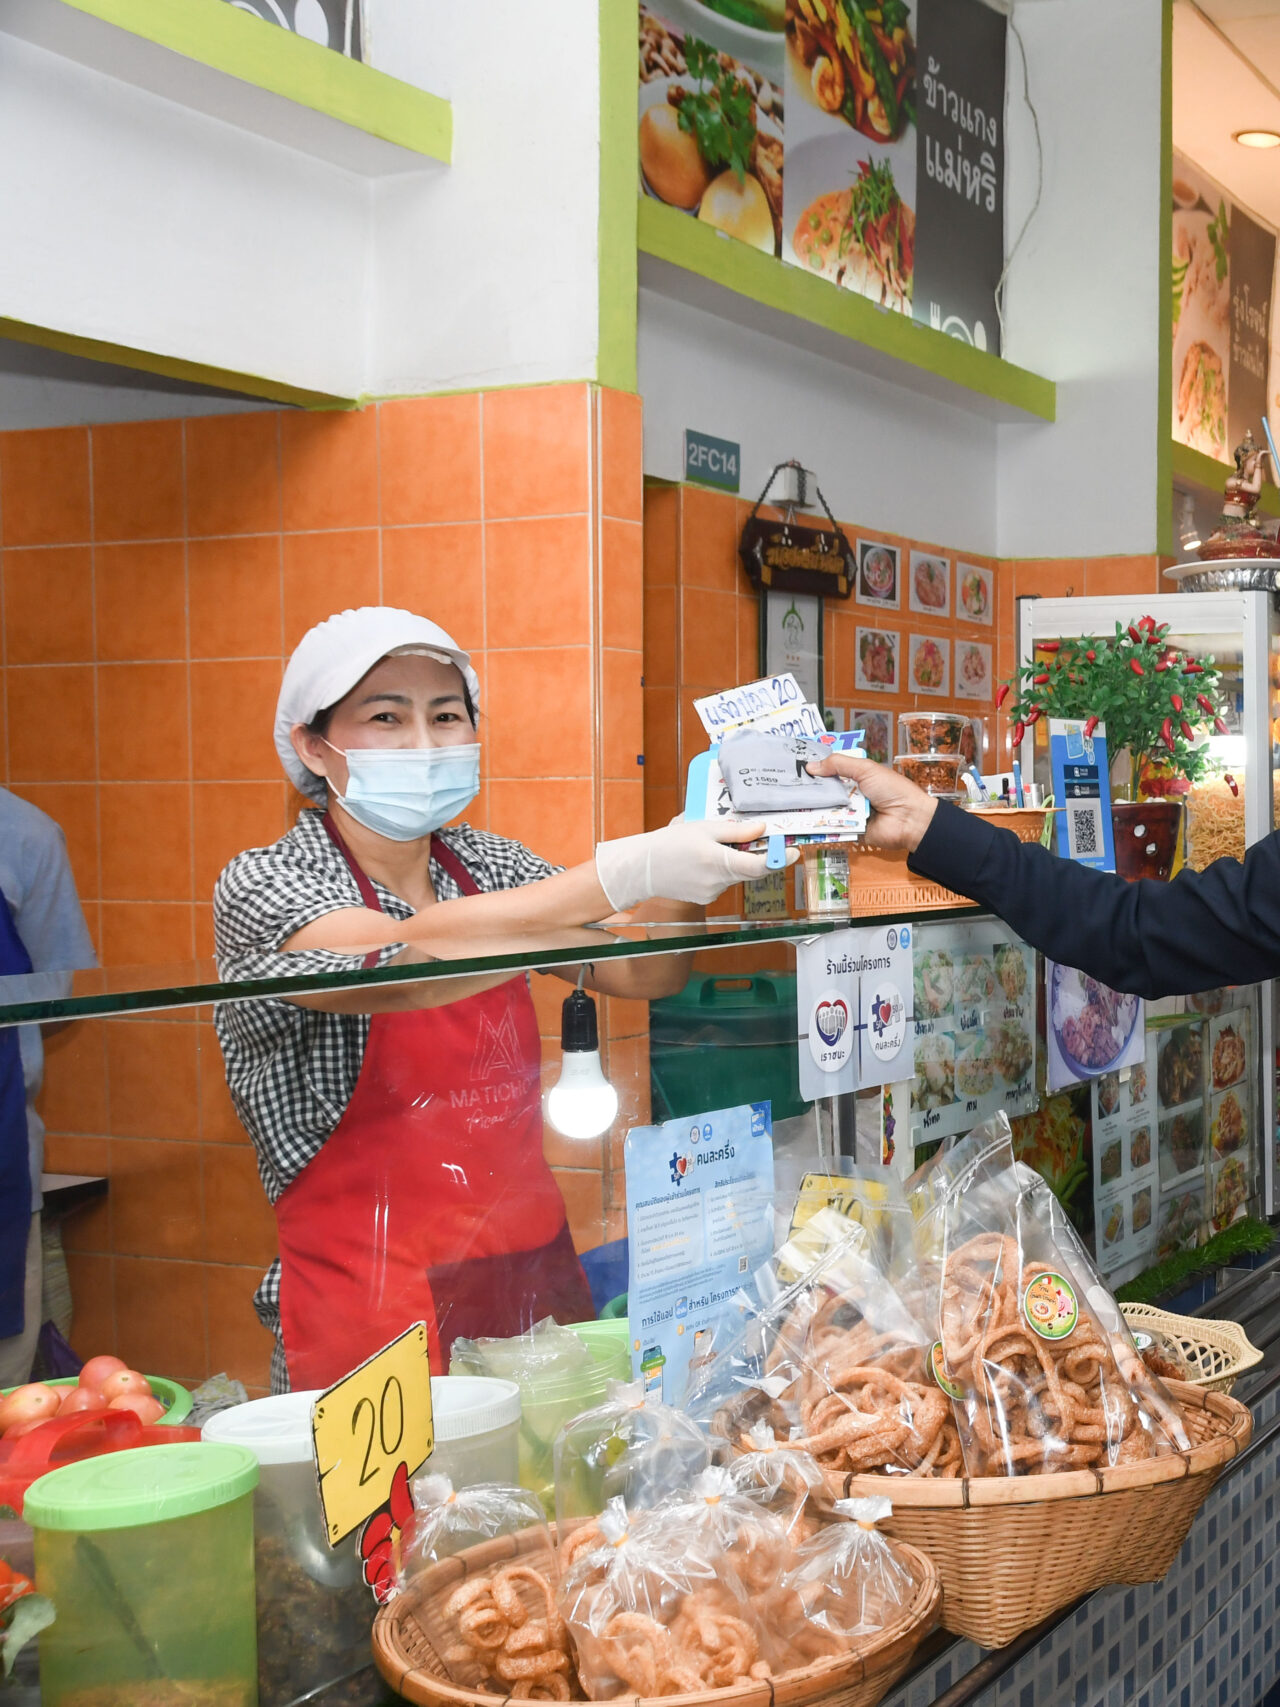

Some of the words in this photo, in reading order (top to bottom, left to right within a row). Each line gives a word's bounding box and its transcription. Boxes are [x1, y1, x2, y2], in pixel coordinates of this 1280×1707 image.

[923, 56, 997, 147] ข้าวแกง
[687, 443, 738, 477] 2FC14
[772, 677, 798, 706] 20
[827, 954, 891, 976] ร้านนี้ร่วมโครงการ
[875, 1032, 902, 1051] คนละครึ่ง
[820, 1050, 846, 1063] เราชนะ
[697, 1139, 735, 1167] คนละครึ่ง
[351, 1375, 404, 1487] 20
